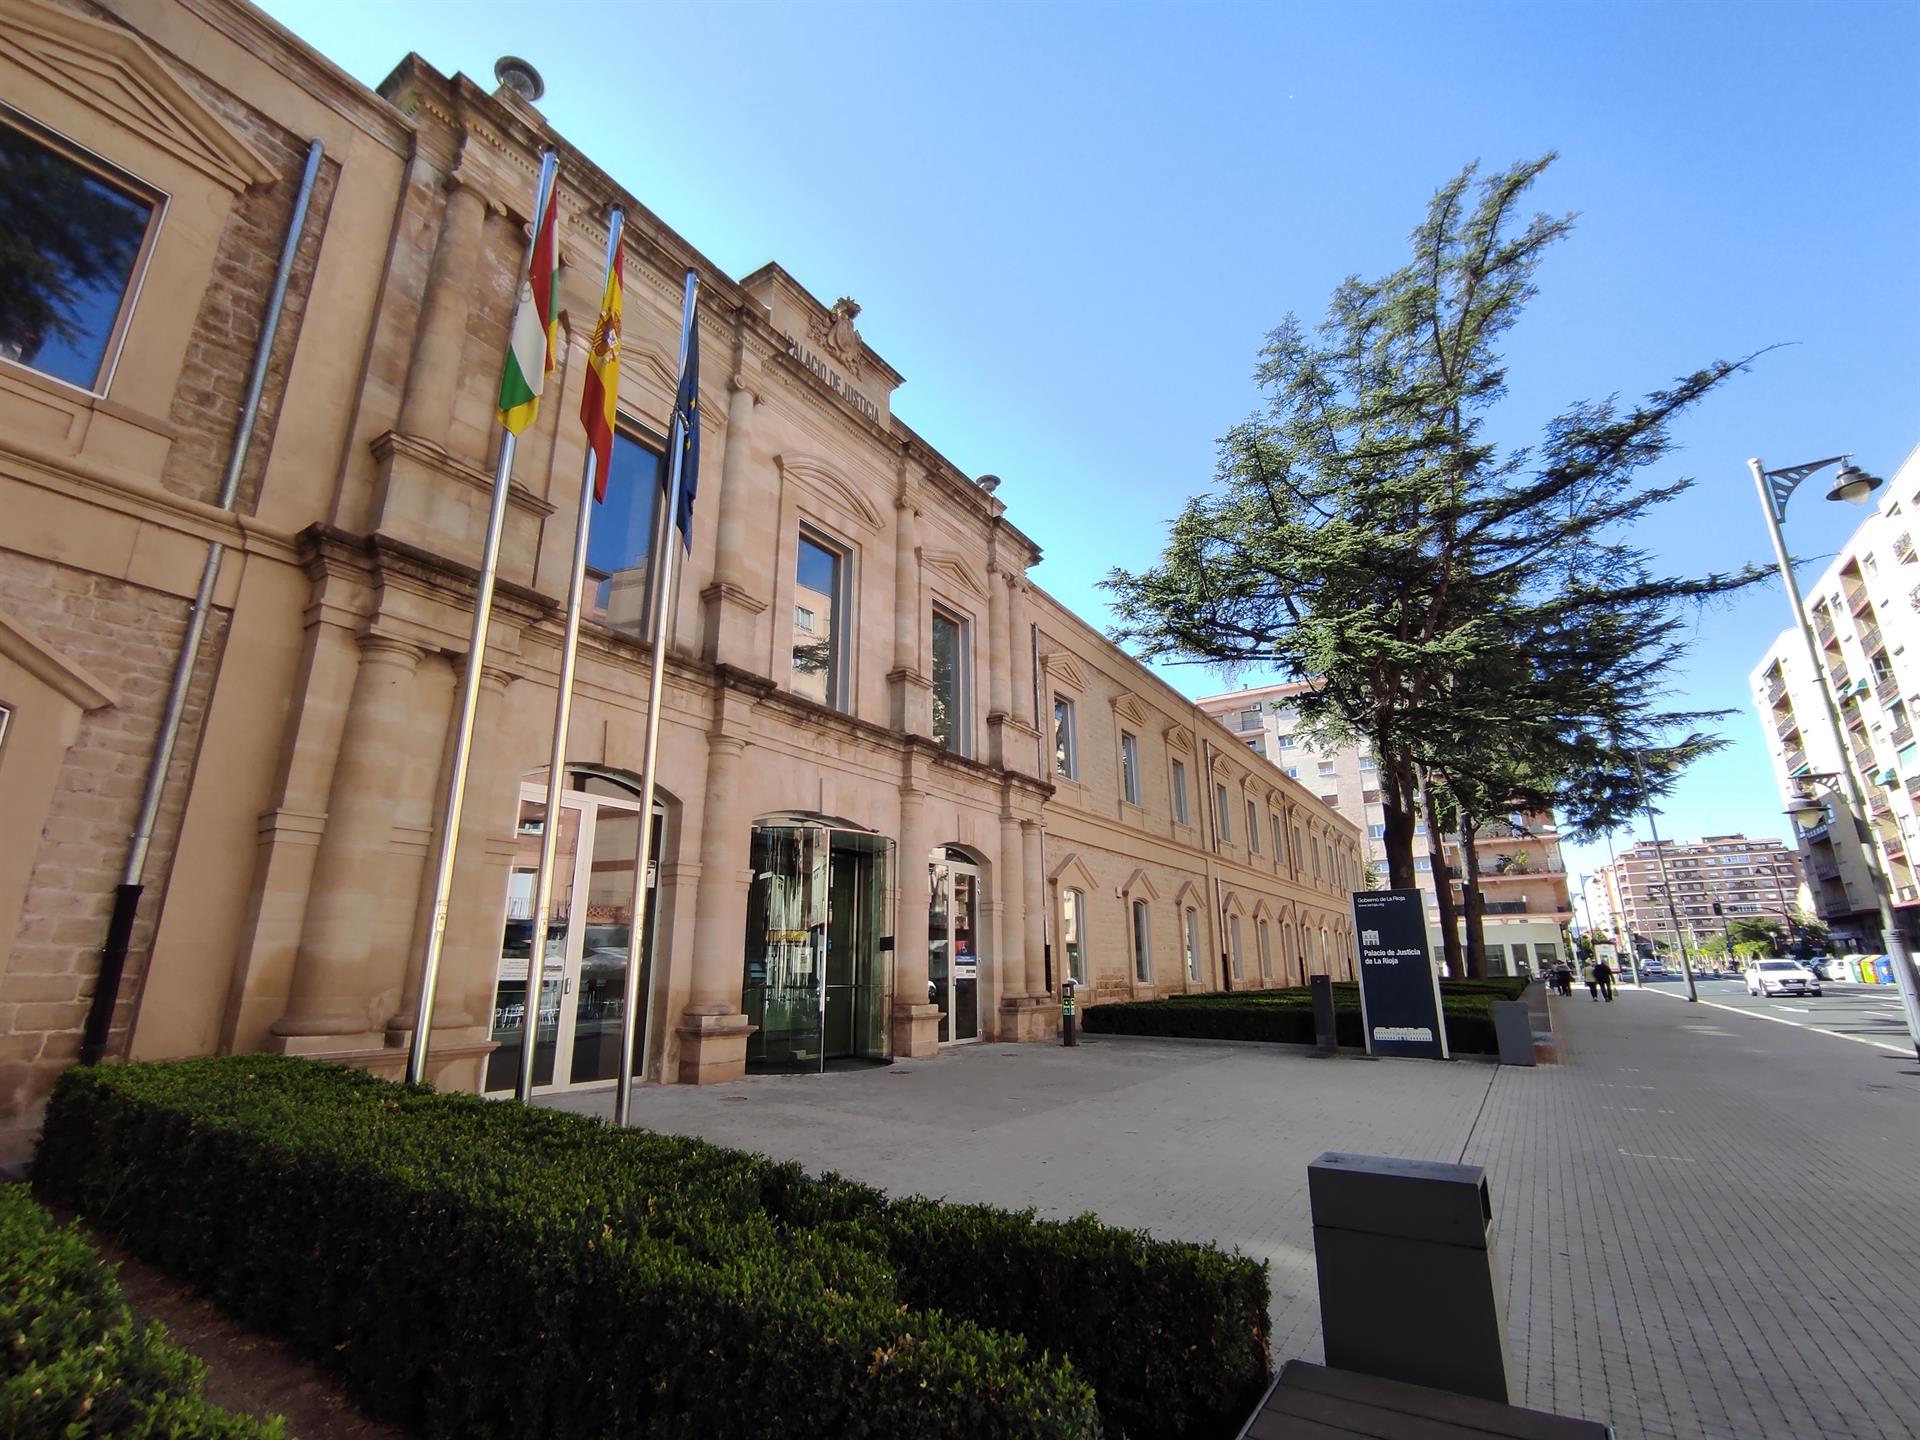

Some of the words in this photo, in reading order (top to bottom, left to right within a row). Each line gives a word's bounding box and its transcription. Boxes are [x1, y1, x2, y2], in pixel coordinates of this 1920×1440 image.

[830, 369, 841, 392] DE
[843, 382, 880, 425] JUSTICIA
[1393, 895, 1405, 903] Rioja
[1383, 957, 1399, 966] Rioja
